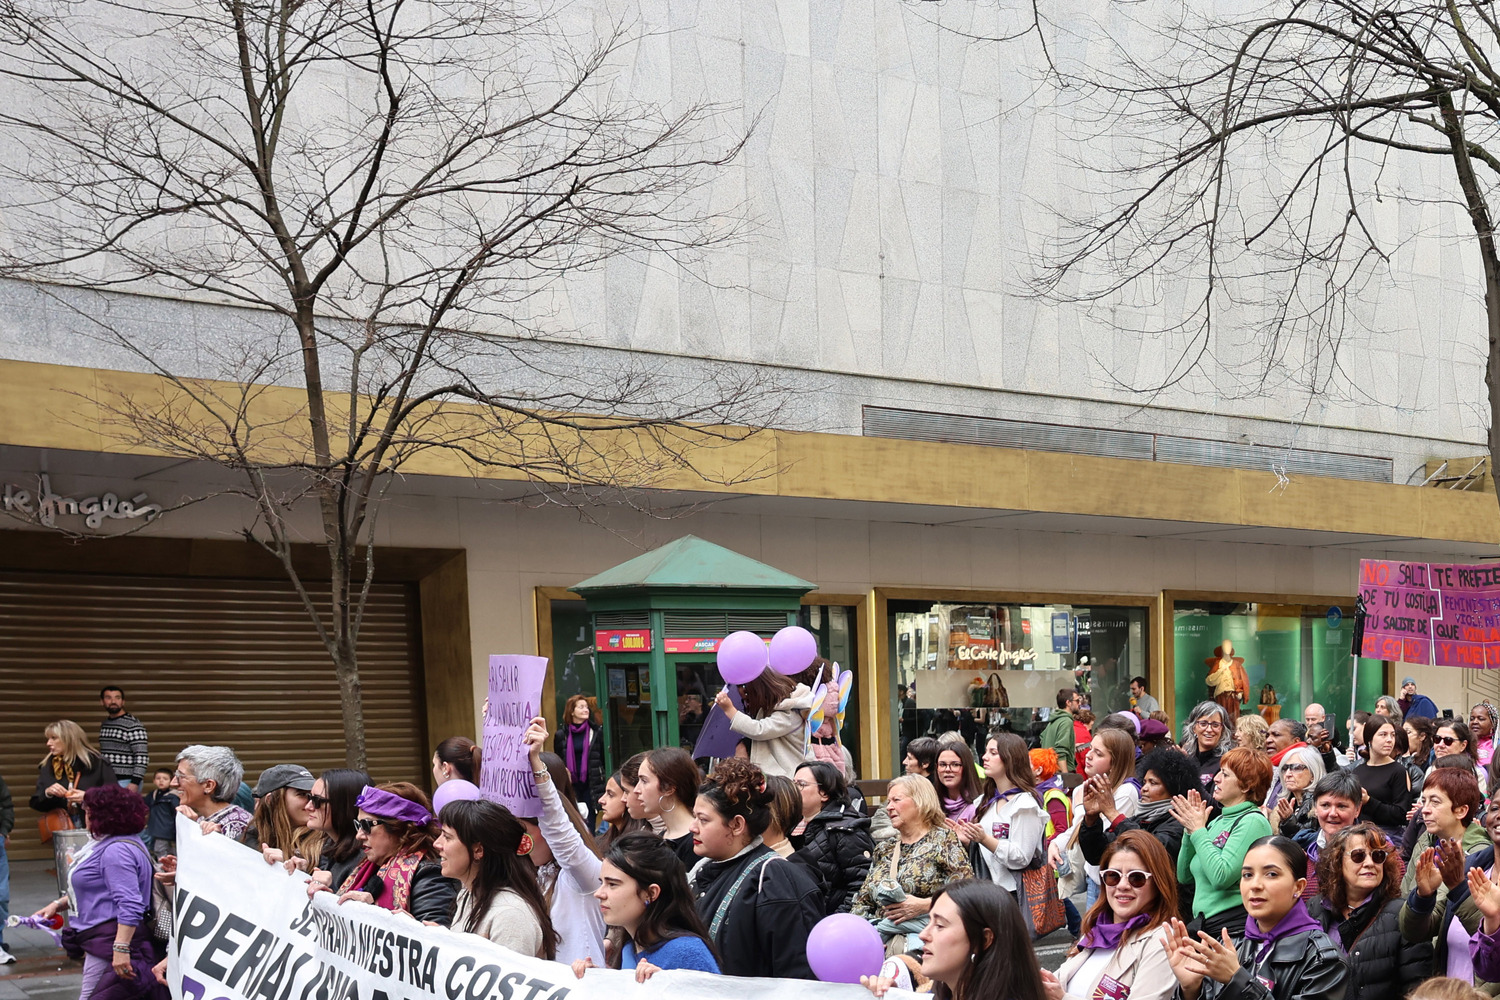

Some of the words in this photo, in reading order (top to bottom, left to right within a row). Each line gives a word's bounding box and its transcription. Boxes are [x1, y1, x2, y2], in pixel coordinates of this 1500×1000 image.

[39, 473, 162, 529] Inglés
[1364, 563, 1390, 587] NO
[1434, 567, 1454, 587] TE
[1363, 589, 1377, 605] DE
[1384, 588, 1399, 608] TÚ
[1365, 609, 1379, 630] TÚ
[1383, 615, 1415, 633] SALISTE
[1417, 618, 1428, 635] DE
[1436, 623, 1460, 640] QUE
[957, 645, 970, 661] El
[970, 645, 998, 660] Corte
[998, 642, 1039, 665] Inglés
[1361, 636, 1376, 652] MI
[1382, 638, 1421, 658] COÑO
[1441, 643, 1452, 662] Y
[498, 664, 520, 693] SALIR
